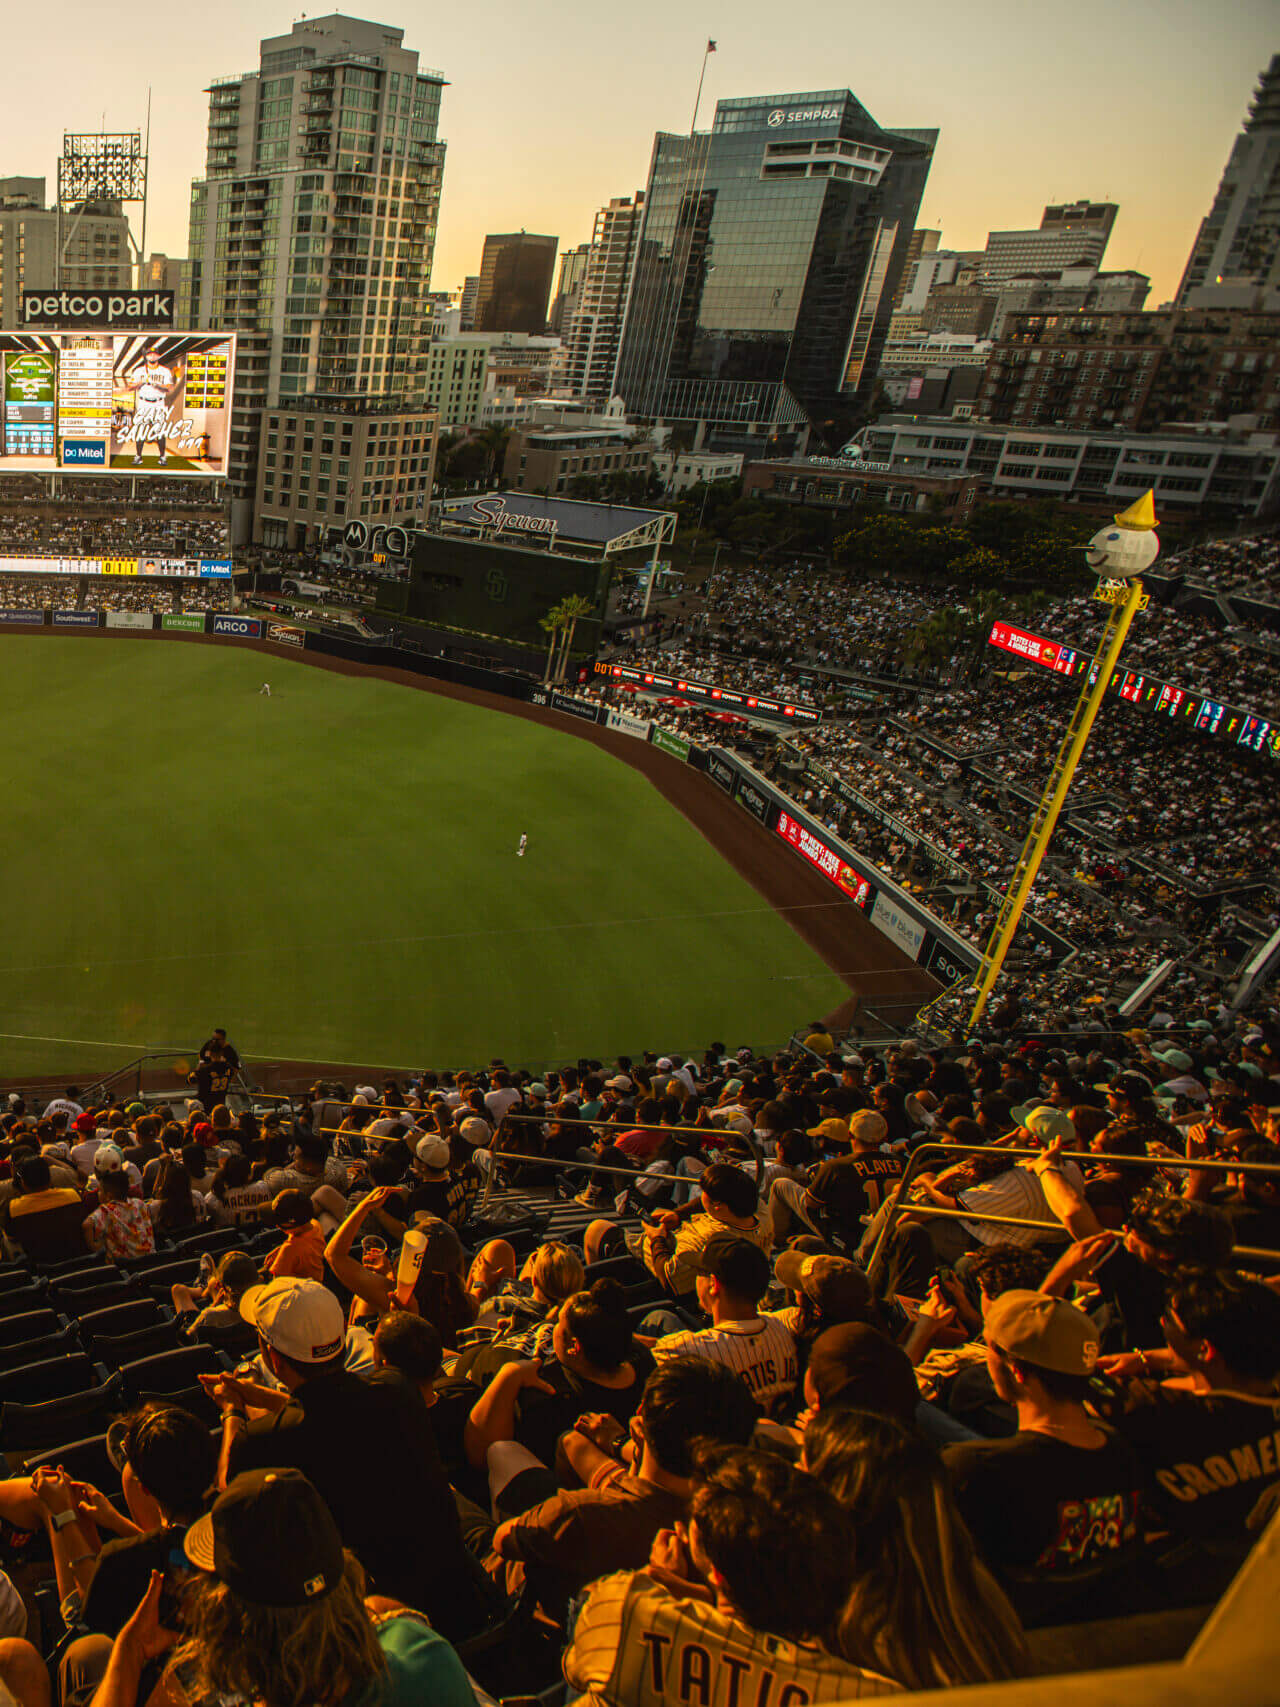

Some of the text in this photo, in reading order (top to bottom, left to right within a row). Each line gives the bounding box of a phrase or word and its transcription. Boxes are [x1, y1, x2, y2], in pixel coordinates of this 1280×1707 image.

[787, 109, 838, 122] SEMPRA
[25, 291, 169, 322] petco park
[133, 405, 175, 425] GARY
[116, 419, 193, 444] SANCHEZ
[78, 448, 104, 458] Mitel
[470, 497, 559, 534] Sycuan
[210, 564, 230, 574] Mitel
[56, 614, 91, 623] Southwest
[216, 621, 248, 633] ARCO
[270, 624, 300, 641] Sycuan
[622, 670, 640, 679] TOYOTA
[1111, 674, 1120, 686] F
[654, 678, 673, 687] TOYOTA
[687, 684, 707, 695] TOYOTA
[1146, 688, 1156, 700] F
[721, 692, 742, 703] TOYOTA
[1173, 690, 1182, 704] 3
[756, 700, 779, 712] TOYOTA
[1184, 702, 1196, 716] F
[1216, 706, 1226, 719] 3
[794, 708, 818, 720] TOYOTA
[1228, 718, 1238, 732] F
[800, 828, 809, 840] UP
[824, 850, 841, 869] FREE
[875, 900, 891, 921] blue
[896, 920, 914, 940] blue
[211, 1077, 228, 1092] 23
[853, 1159, 903, 1177] PLAYER
